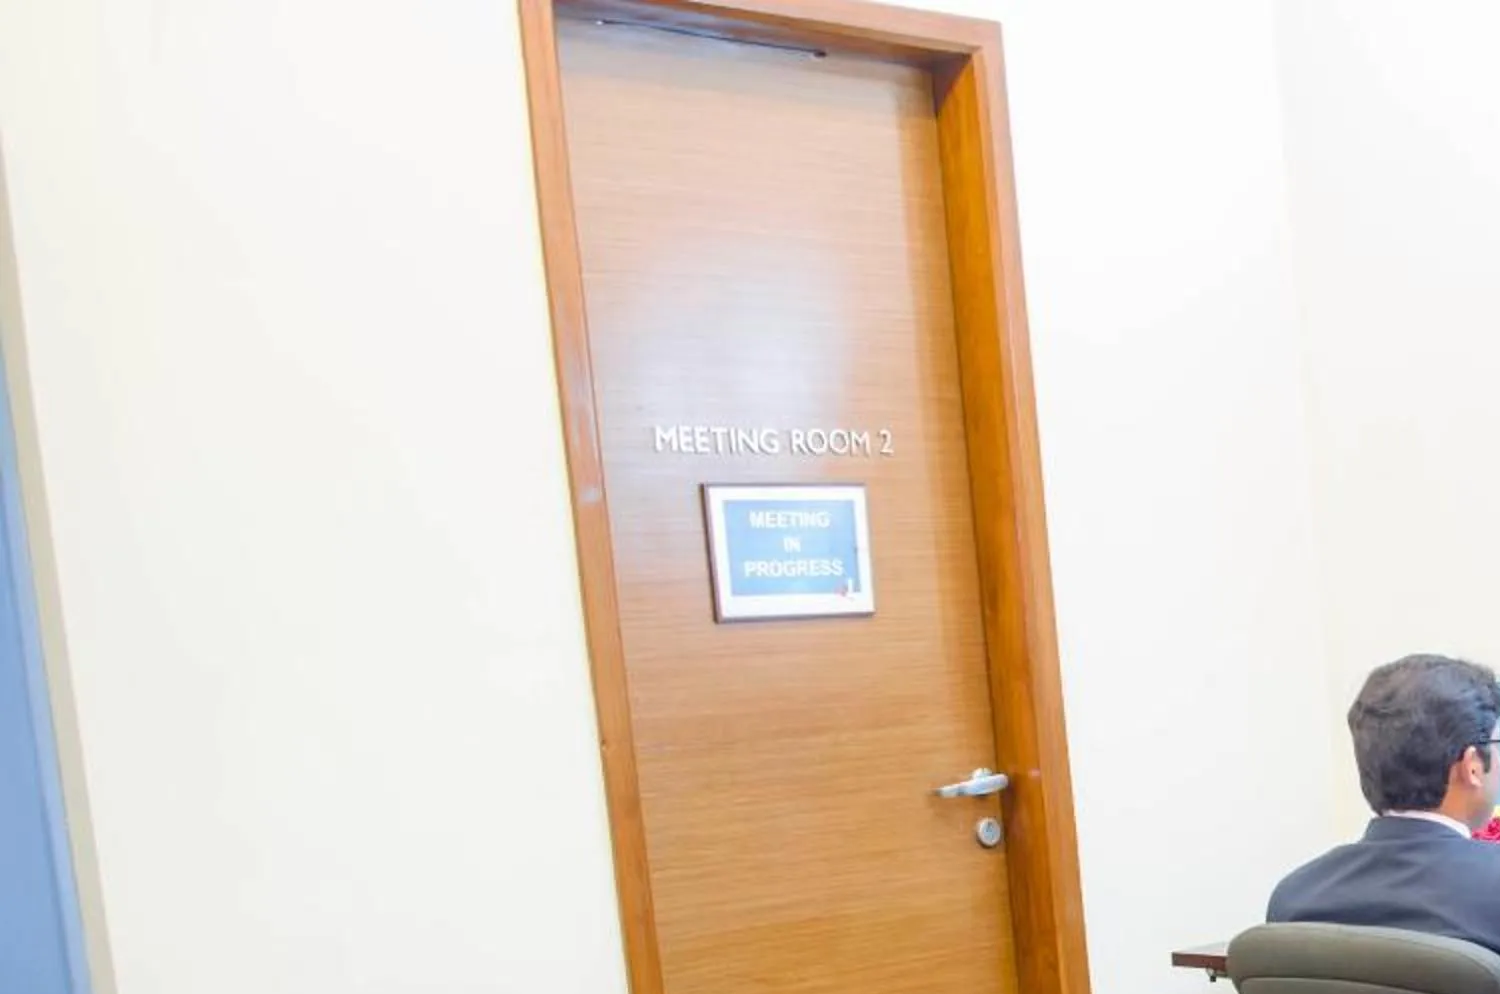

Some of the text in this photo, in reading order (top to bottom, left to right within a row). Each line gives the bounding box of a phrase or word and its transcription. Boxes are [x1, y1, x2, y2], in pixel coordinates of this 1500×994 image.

[653, 425, 895, 456] MEETING ROOM 2
[749, 509, 832, 528] MEETING
[782, 536, 802, 553] IN
[743, 558, 844, 577] PROGRESS
